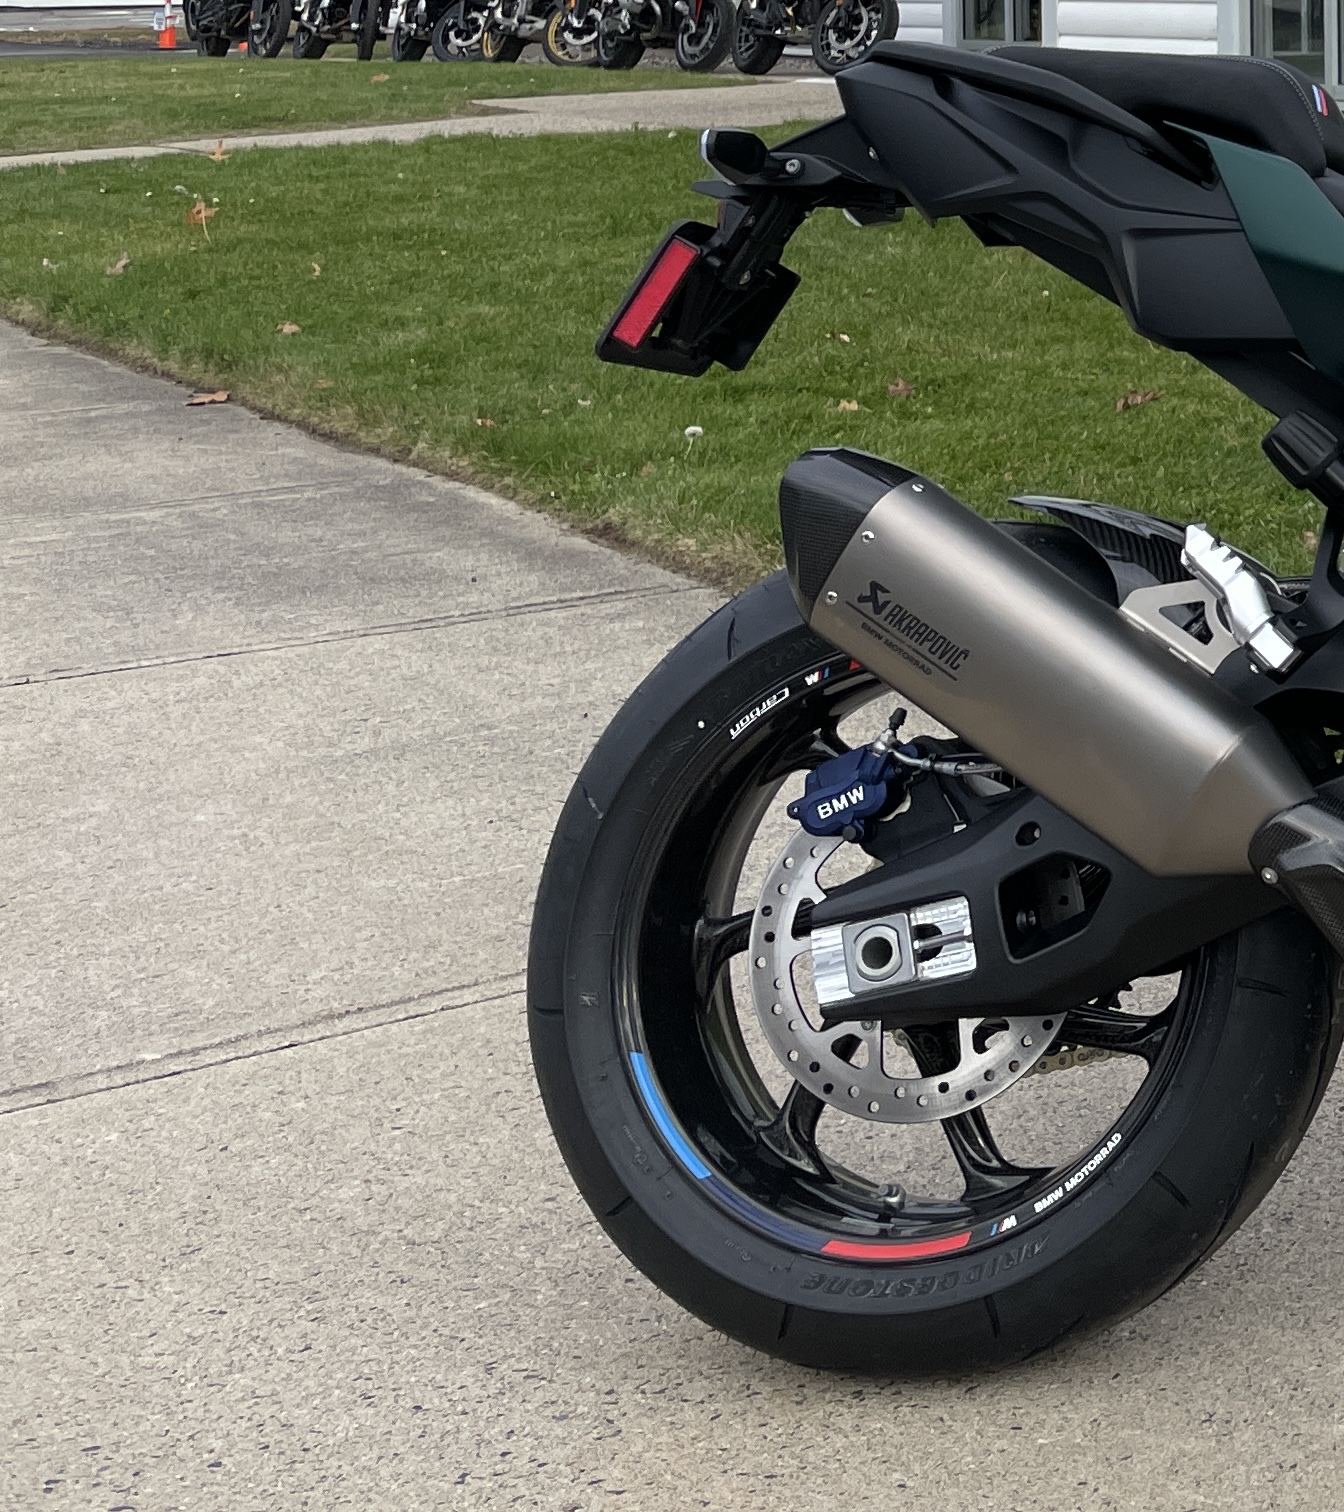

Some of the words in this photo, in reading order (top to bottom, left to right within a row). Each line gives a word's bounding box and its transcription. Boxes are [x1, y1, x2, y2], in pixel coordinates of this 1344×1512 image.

[729, 687, 790, 740] Carbon
[817, 785, 864, 820] BMW
[1033, 1187, 1064, 1213] BMW
[1064, 1132, 1122, 1191] MOTORRAD
